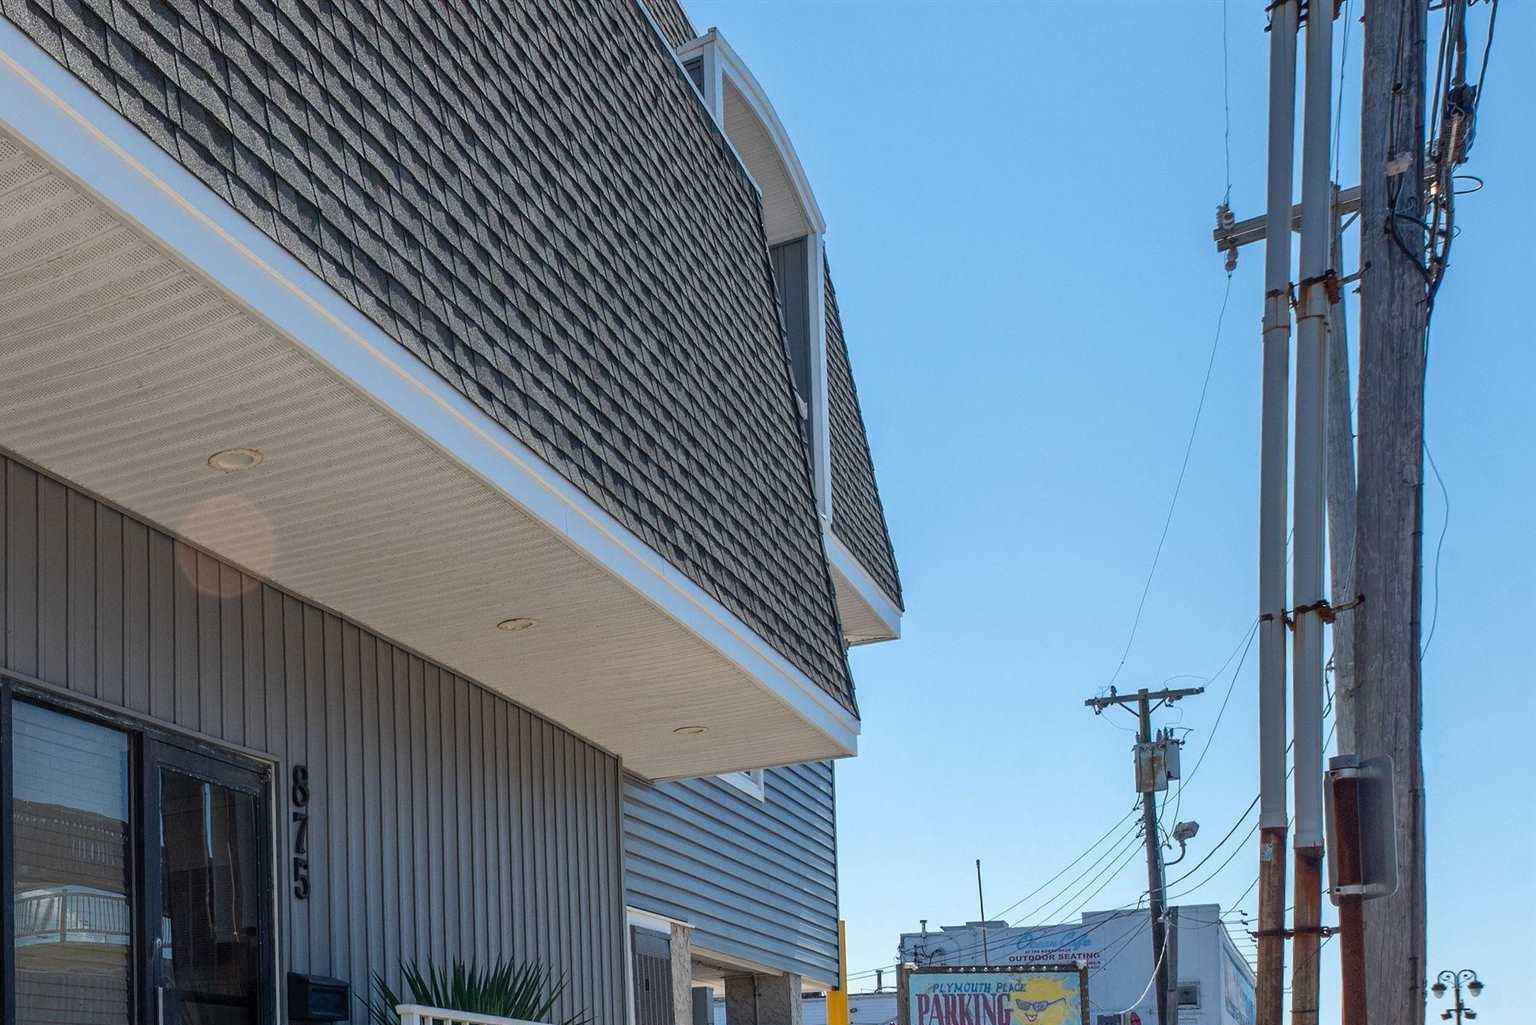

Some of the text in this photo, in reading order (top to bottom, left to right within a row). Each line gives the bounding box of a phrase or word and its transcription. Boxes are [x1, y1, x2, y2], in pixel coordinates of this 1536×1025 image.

[1008, 952, 1101, 962] OUTDOOR SEATING
[932, 982, 1027, 994] PLYMOUTH PLACE
